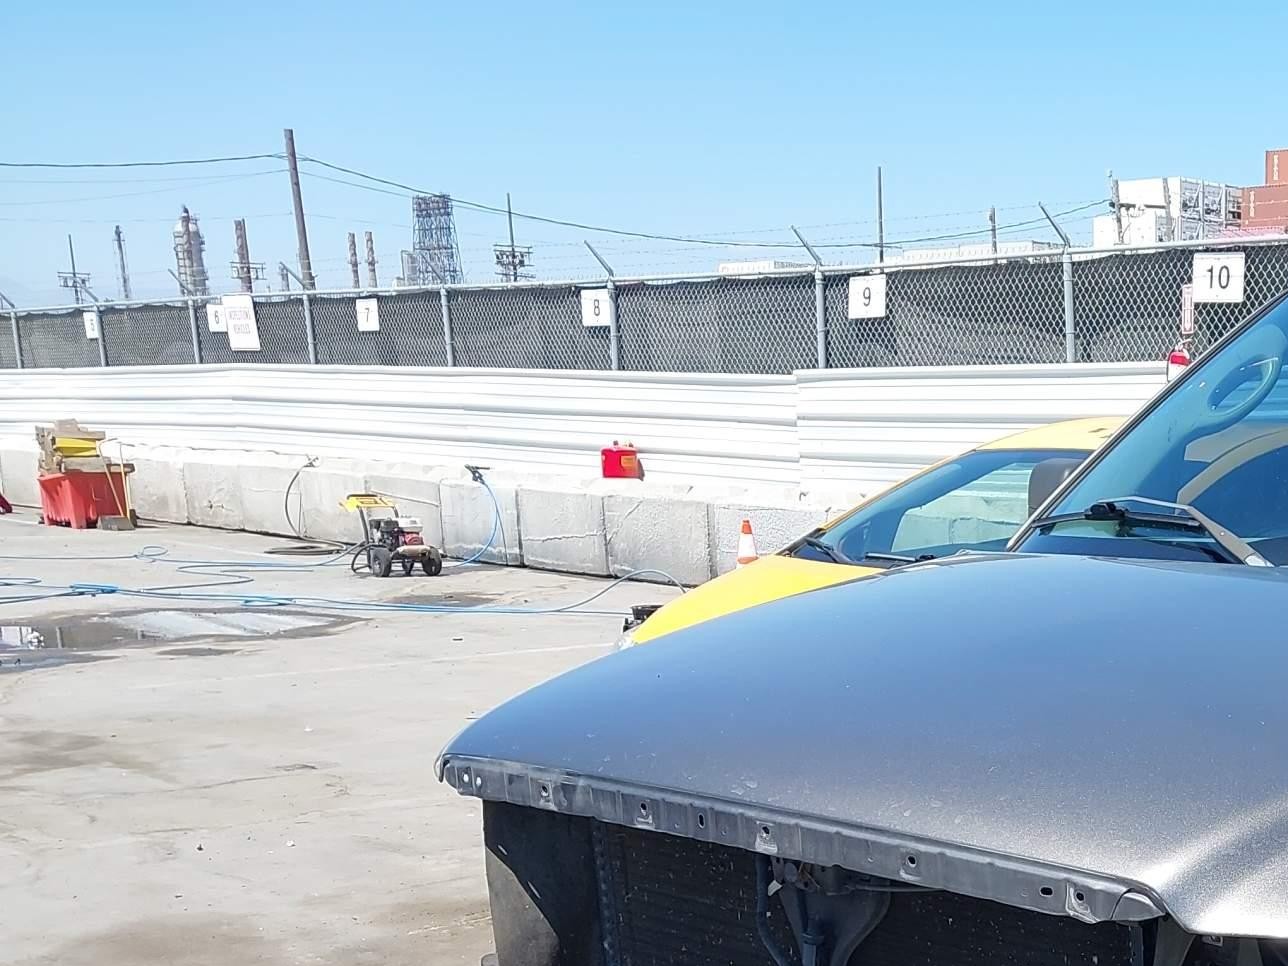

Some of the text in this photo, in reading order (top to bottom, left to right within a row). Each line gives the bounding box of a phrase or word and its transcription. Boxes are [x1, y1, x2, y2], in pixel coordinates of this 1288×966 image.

[1206, 265, 1231, 289] 10
[862, 287, 871, 307] 9
[213, 309, 221, 325] 6
[364, 307, 371, 323] 7
[593, 299, 601, 317] 8
